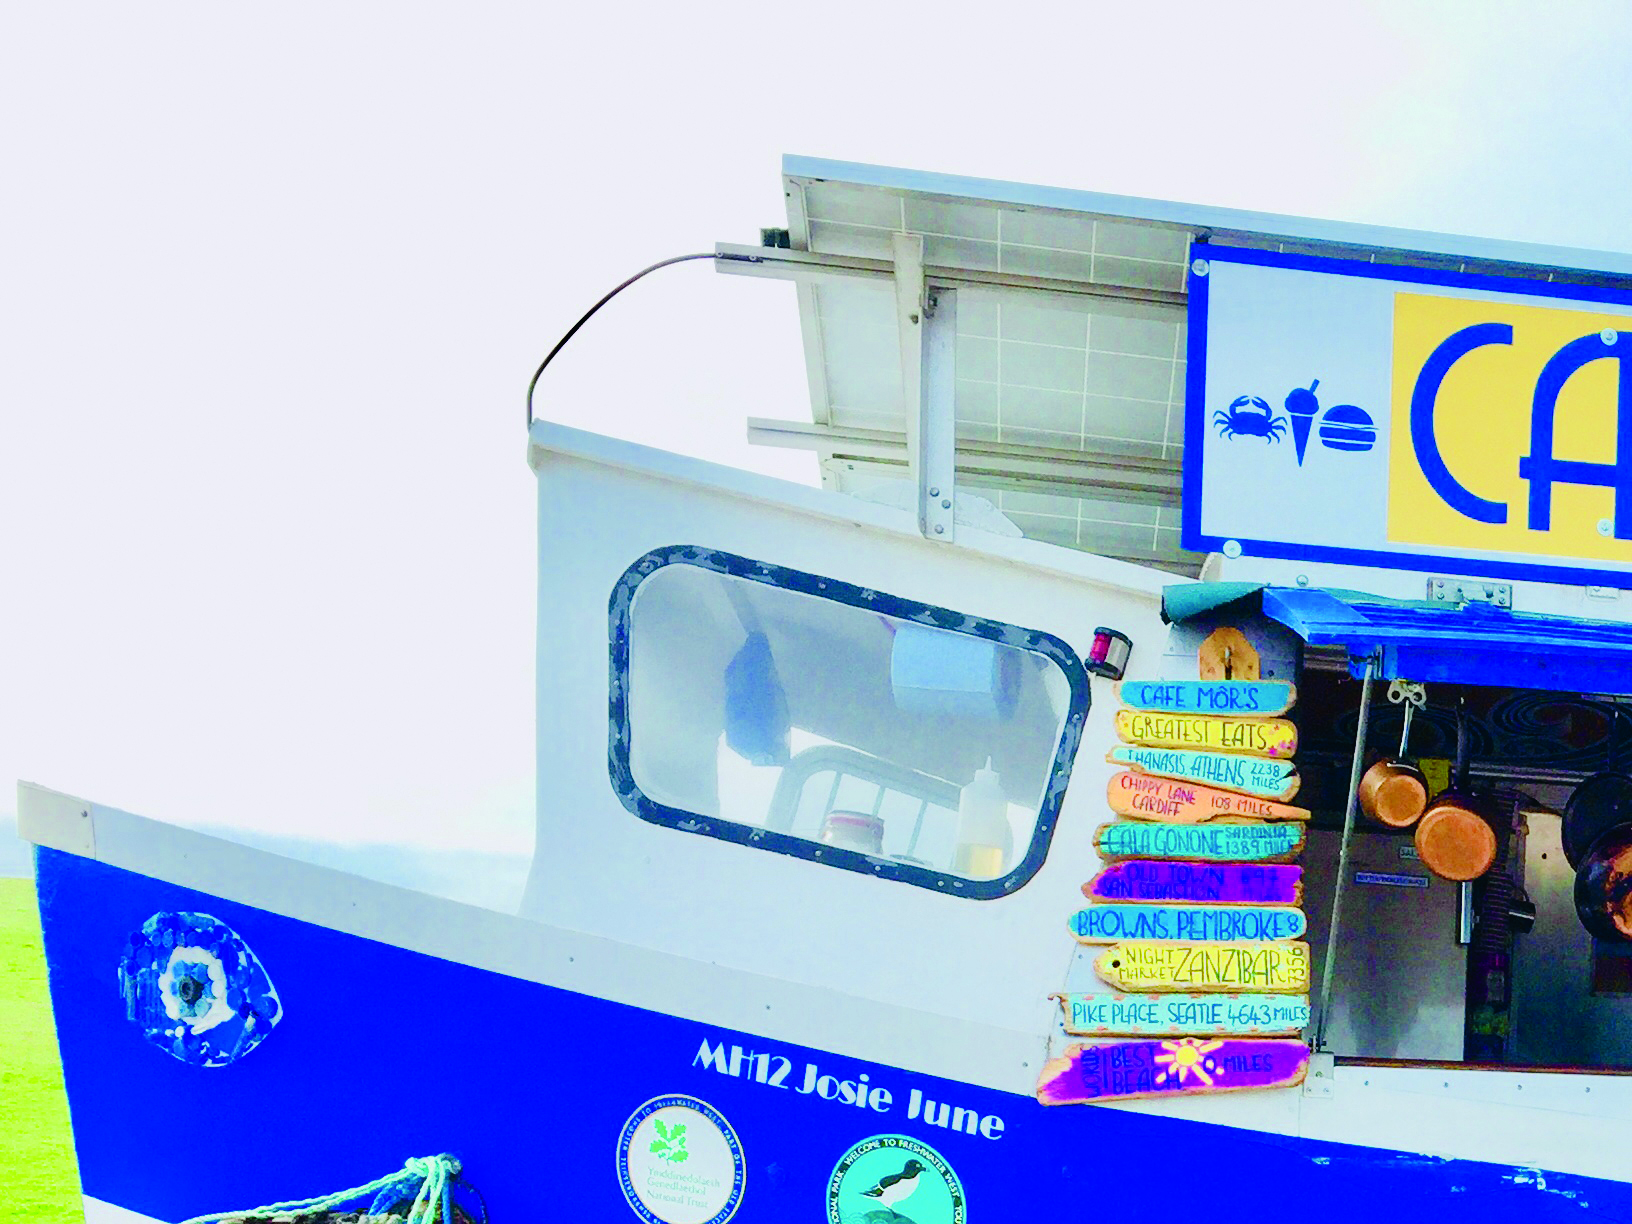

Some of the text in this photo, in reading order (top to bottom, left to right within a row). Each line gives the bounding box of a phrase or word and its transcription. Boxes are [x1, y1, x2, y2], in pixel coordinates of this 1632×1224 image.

[1141, 685, 1185, 707] CAFE
[1132, 716, 1267, 750] GREATEST EATS
[1191, 756, 1280, 787] ATHENS 2238
[1252, 776, 1280, 790] MILES
[1121, 776, 1272, 816] CHIPPY LANE 108 MILES
[1132, 794, 1184, 816] CARDIFF
[1155, 826, 1288, 855] GONONE SARDINIA
[1226, 840, 1259, 855] 1389
[1177, 911, 1298, 941] PEMBROKE 8
[1119, 966, 1175, 980] MARKET
[1126, 947, 1306, 985] NIGHT ZANZIBAR 7356
[1072, 1003, 1107, 1024] PIKE
[1228, 1005, 1271, 1025] 4643
[1274, 1006, 1308, 1021] MILES
[1111, 1046, 1273, 1072] BEST MILES
[1113, 1067, 1183, 1094] BEACH
[795, 1063, 893, 1113] Josie
[905, 1088, 1006, 1141] June
[844, 1138, 960, 1197] WELCOME TO FRESHWATER WEST
[647, 1190, 708, 1208] National Trust
